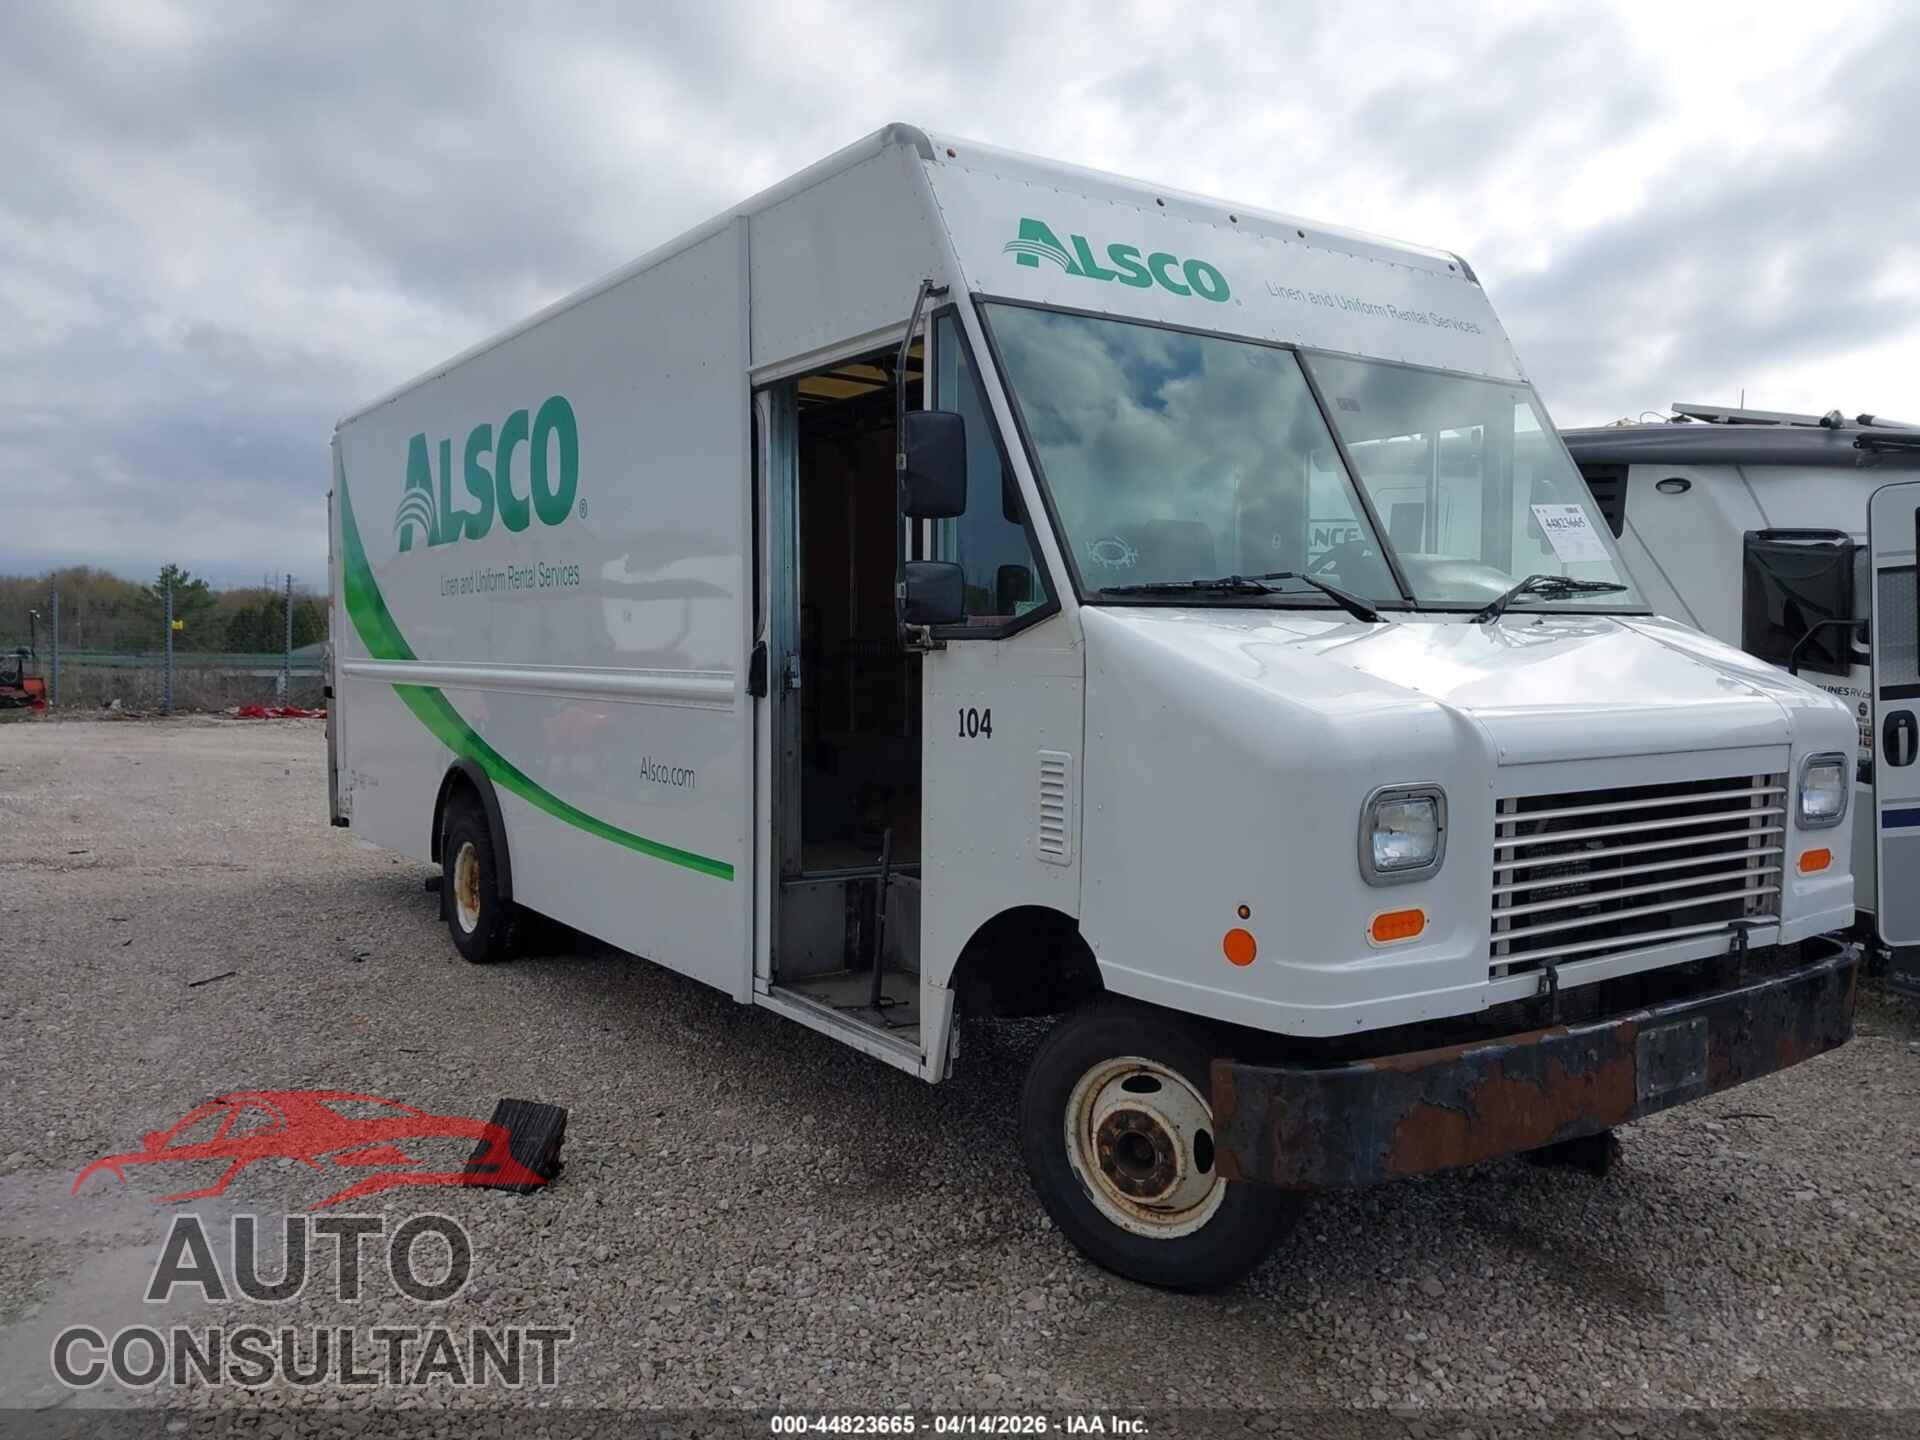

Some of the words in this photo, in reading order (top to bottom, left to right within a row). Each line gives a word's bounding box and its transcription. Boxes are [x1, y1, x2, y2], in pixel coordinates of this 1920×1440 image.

[1003, 217, 1232, 303] ALSCO
[1265, 279, 1305, 301] Linen
[1308, 290, 1336, 308] and
[1335, 294, 1389, 318] Uniform
[1388, 303, 1430, 325] Rental
[1429, 312, 1482, 334] Services
[393, 395, 579, 552] ALSCO
[440, 575, 460, 597] Linen
[460, 570, 474, 594] and
[475, 567, 506, 592] Uniform
[508, 564, 536, 589] Rental
[538, 560, 580, 588] Services
[958, 707, 993, 739] 104
[640, 756, 696, 789] Alsco.com
